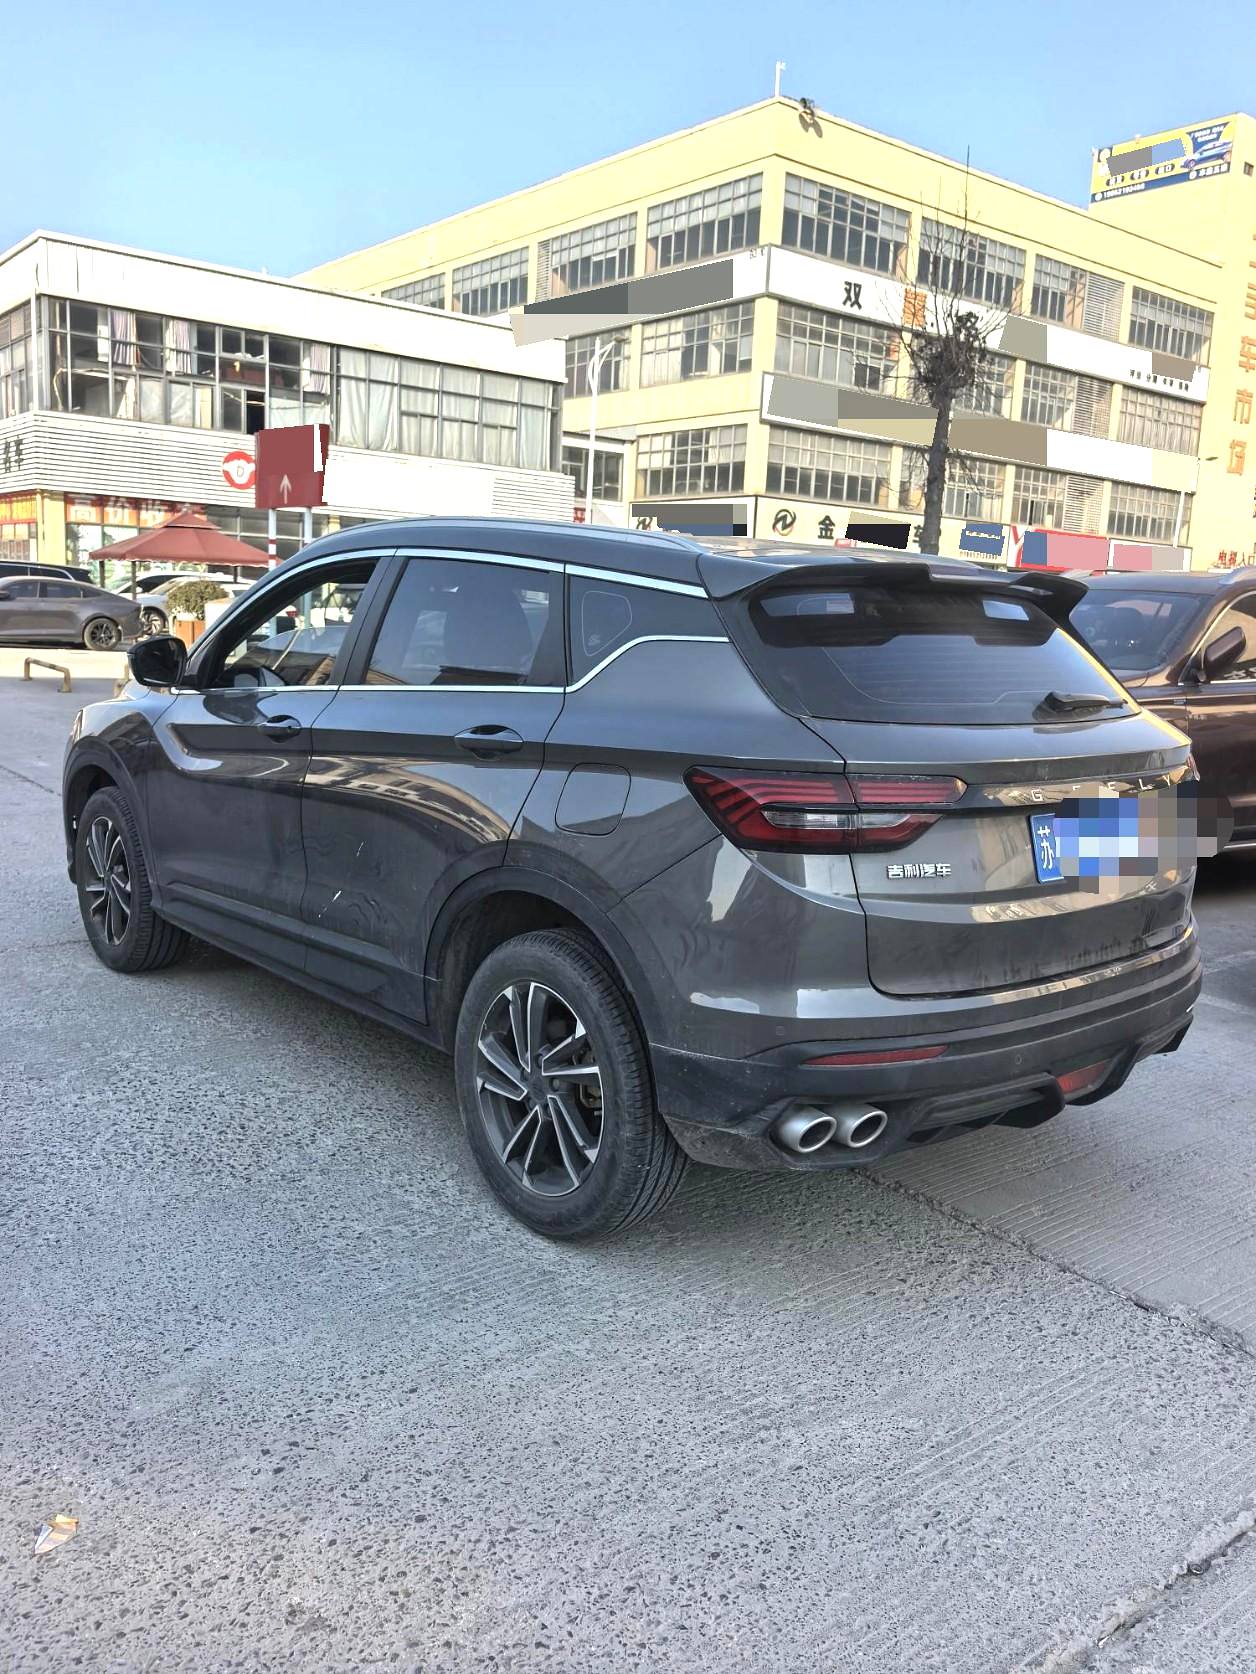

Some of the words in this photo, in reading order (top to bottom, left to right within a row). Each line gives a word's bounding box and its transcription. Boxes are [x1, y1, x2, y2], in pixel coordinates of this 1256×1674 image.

[842, 281, 862, 310] 双
[817, 515, 835, 540] 金
[1037, 825, 1055, 870] 苏
[887, 863, 952, 880] 吉利汽车
